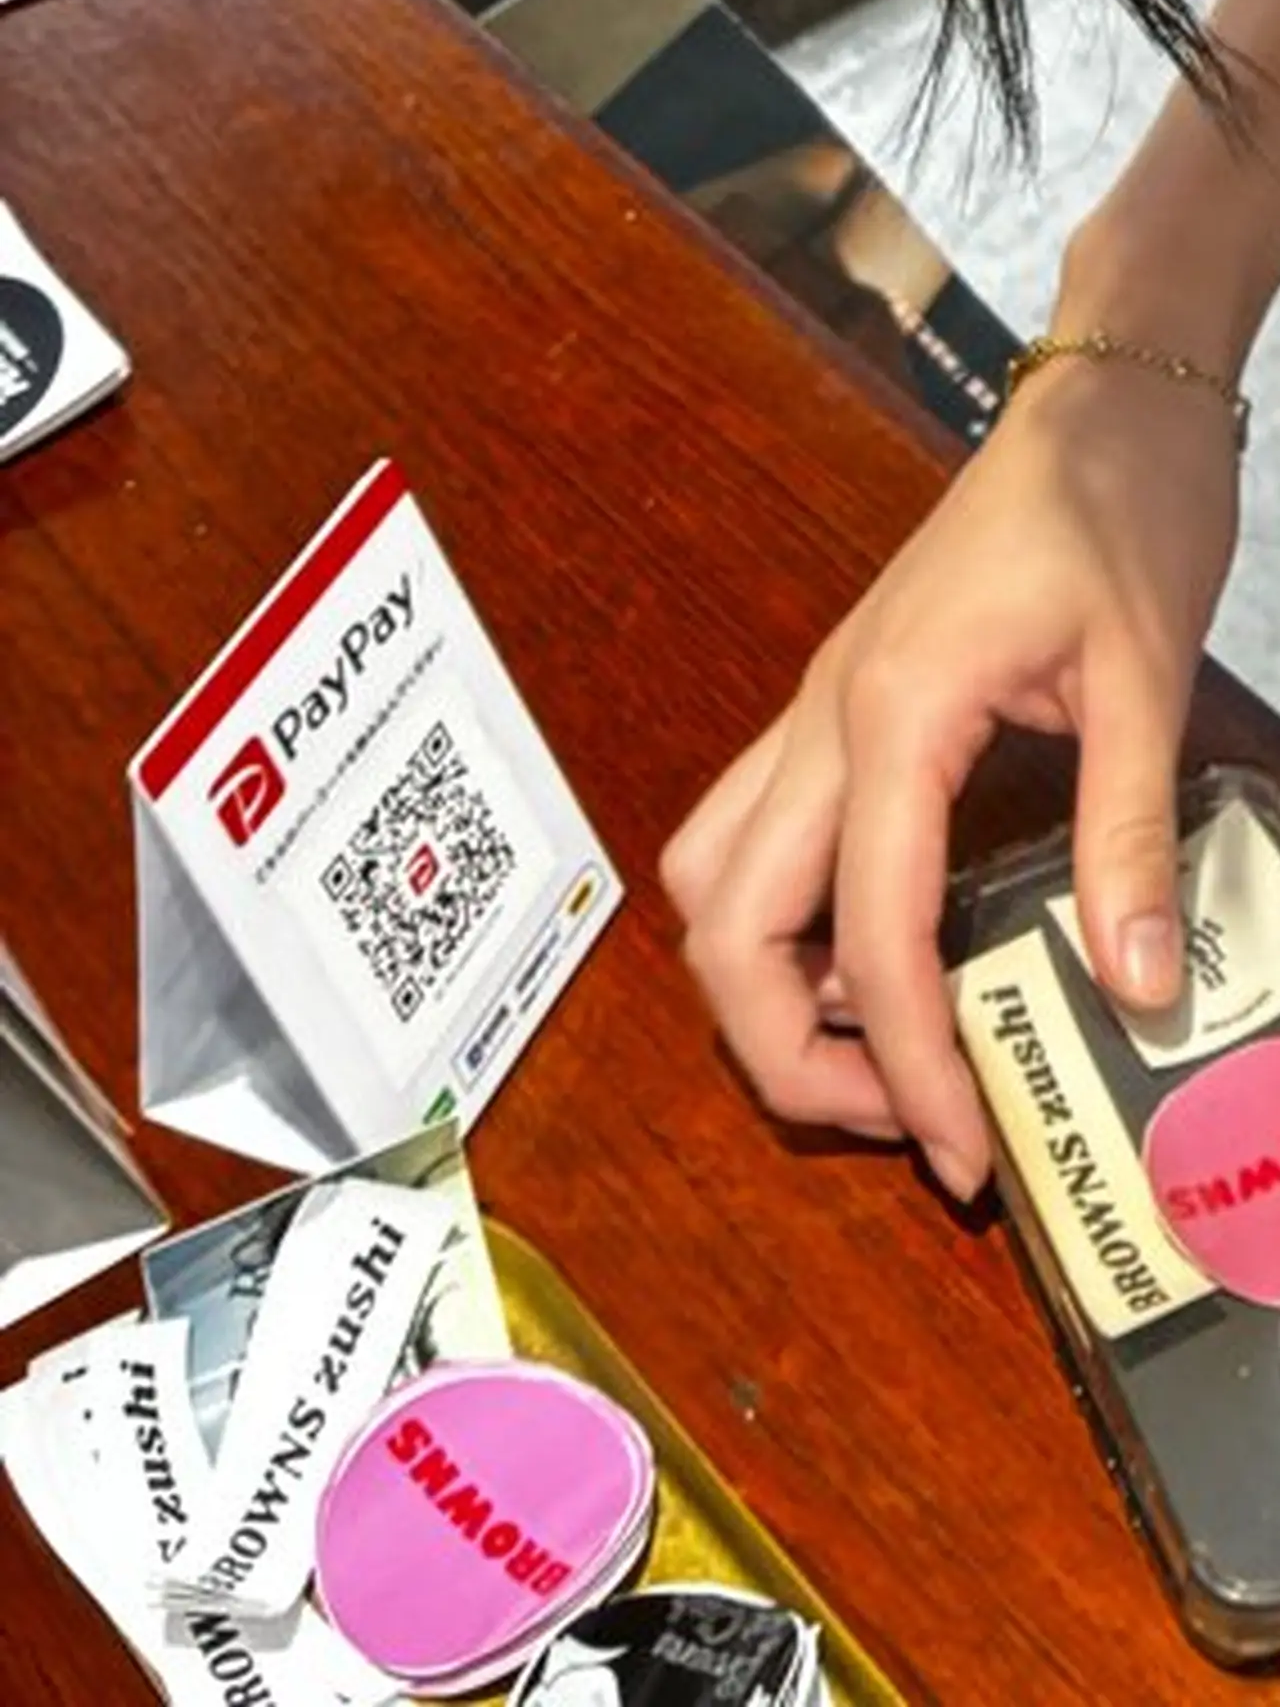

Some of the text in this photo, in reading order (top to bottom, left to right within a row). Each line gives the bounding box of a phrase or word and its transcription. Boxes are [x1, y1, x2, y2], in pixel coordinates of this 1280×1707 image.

[271, 571, 414, 762] PayPay
[981, 984, 1172, 1314] BROWNS zushi
[314, 1217, 408, 1395] zushi
[119, 1359, 189, 1525] zushi
[386, 1417, 573, 1597] BROWNS
